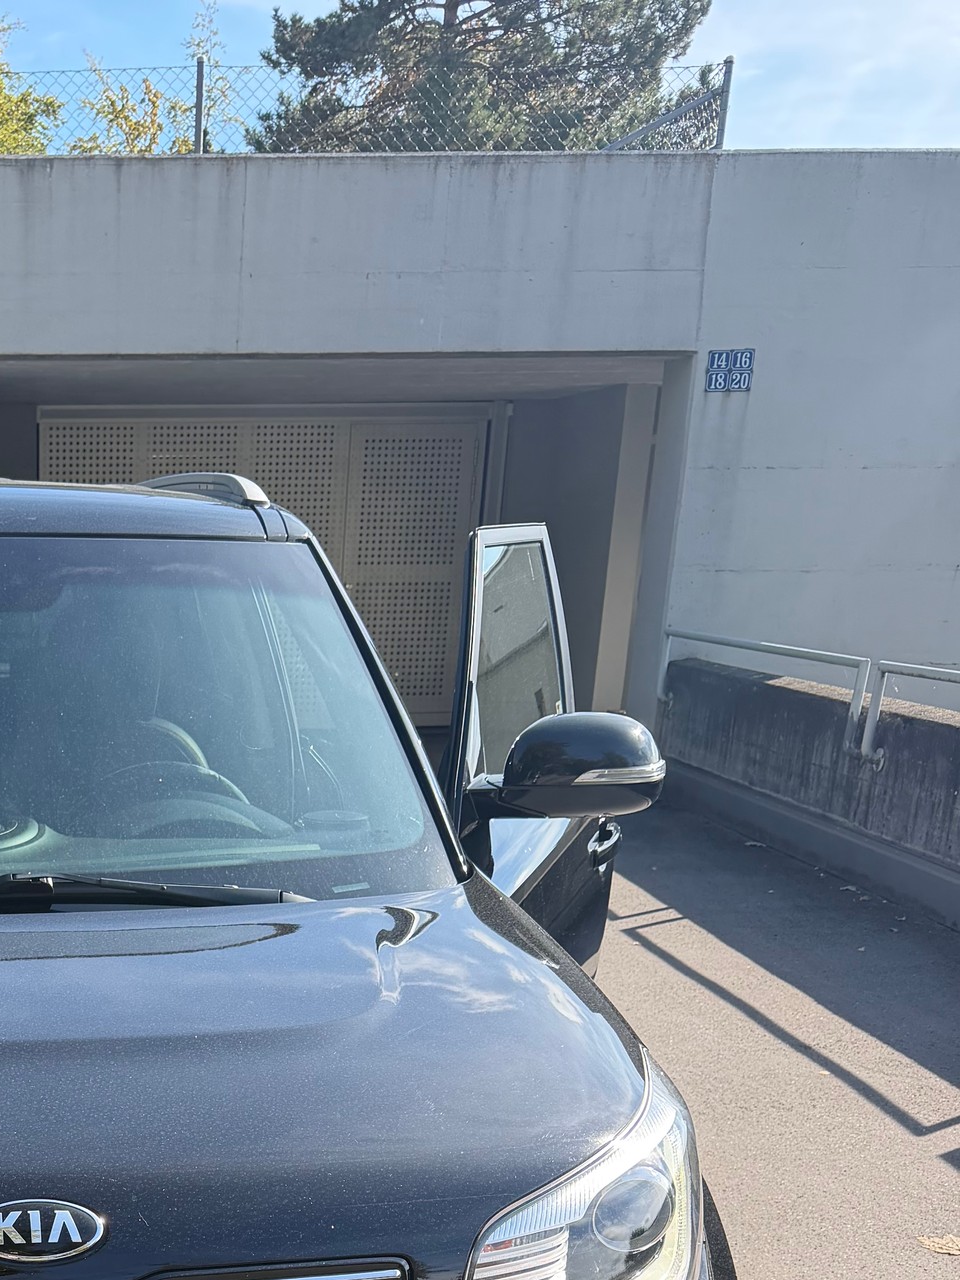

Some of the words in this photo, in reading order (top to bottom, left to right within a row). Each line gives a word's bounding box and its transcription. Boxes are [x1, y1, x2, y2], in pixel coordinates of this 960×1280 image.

[712, 352, 727, 369] 14
[735, 352, 750, 368] 16
[709, 373, 725, 389] 18
[731, 373, 749, 389] 20
